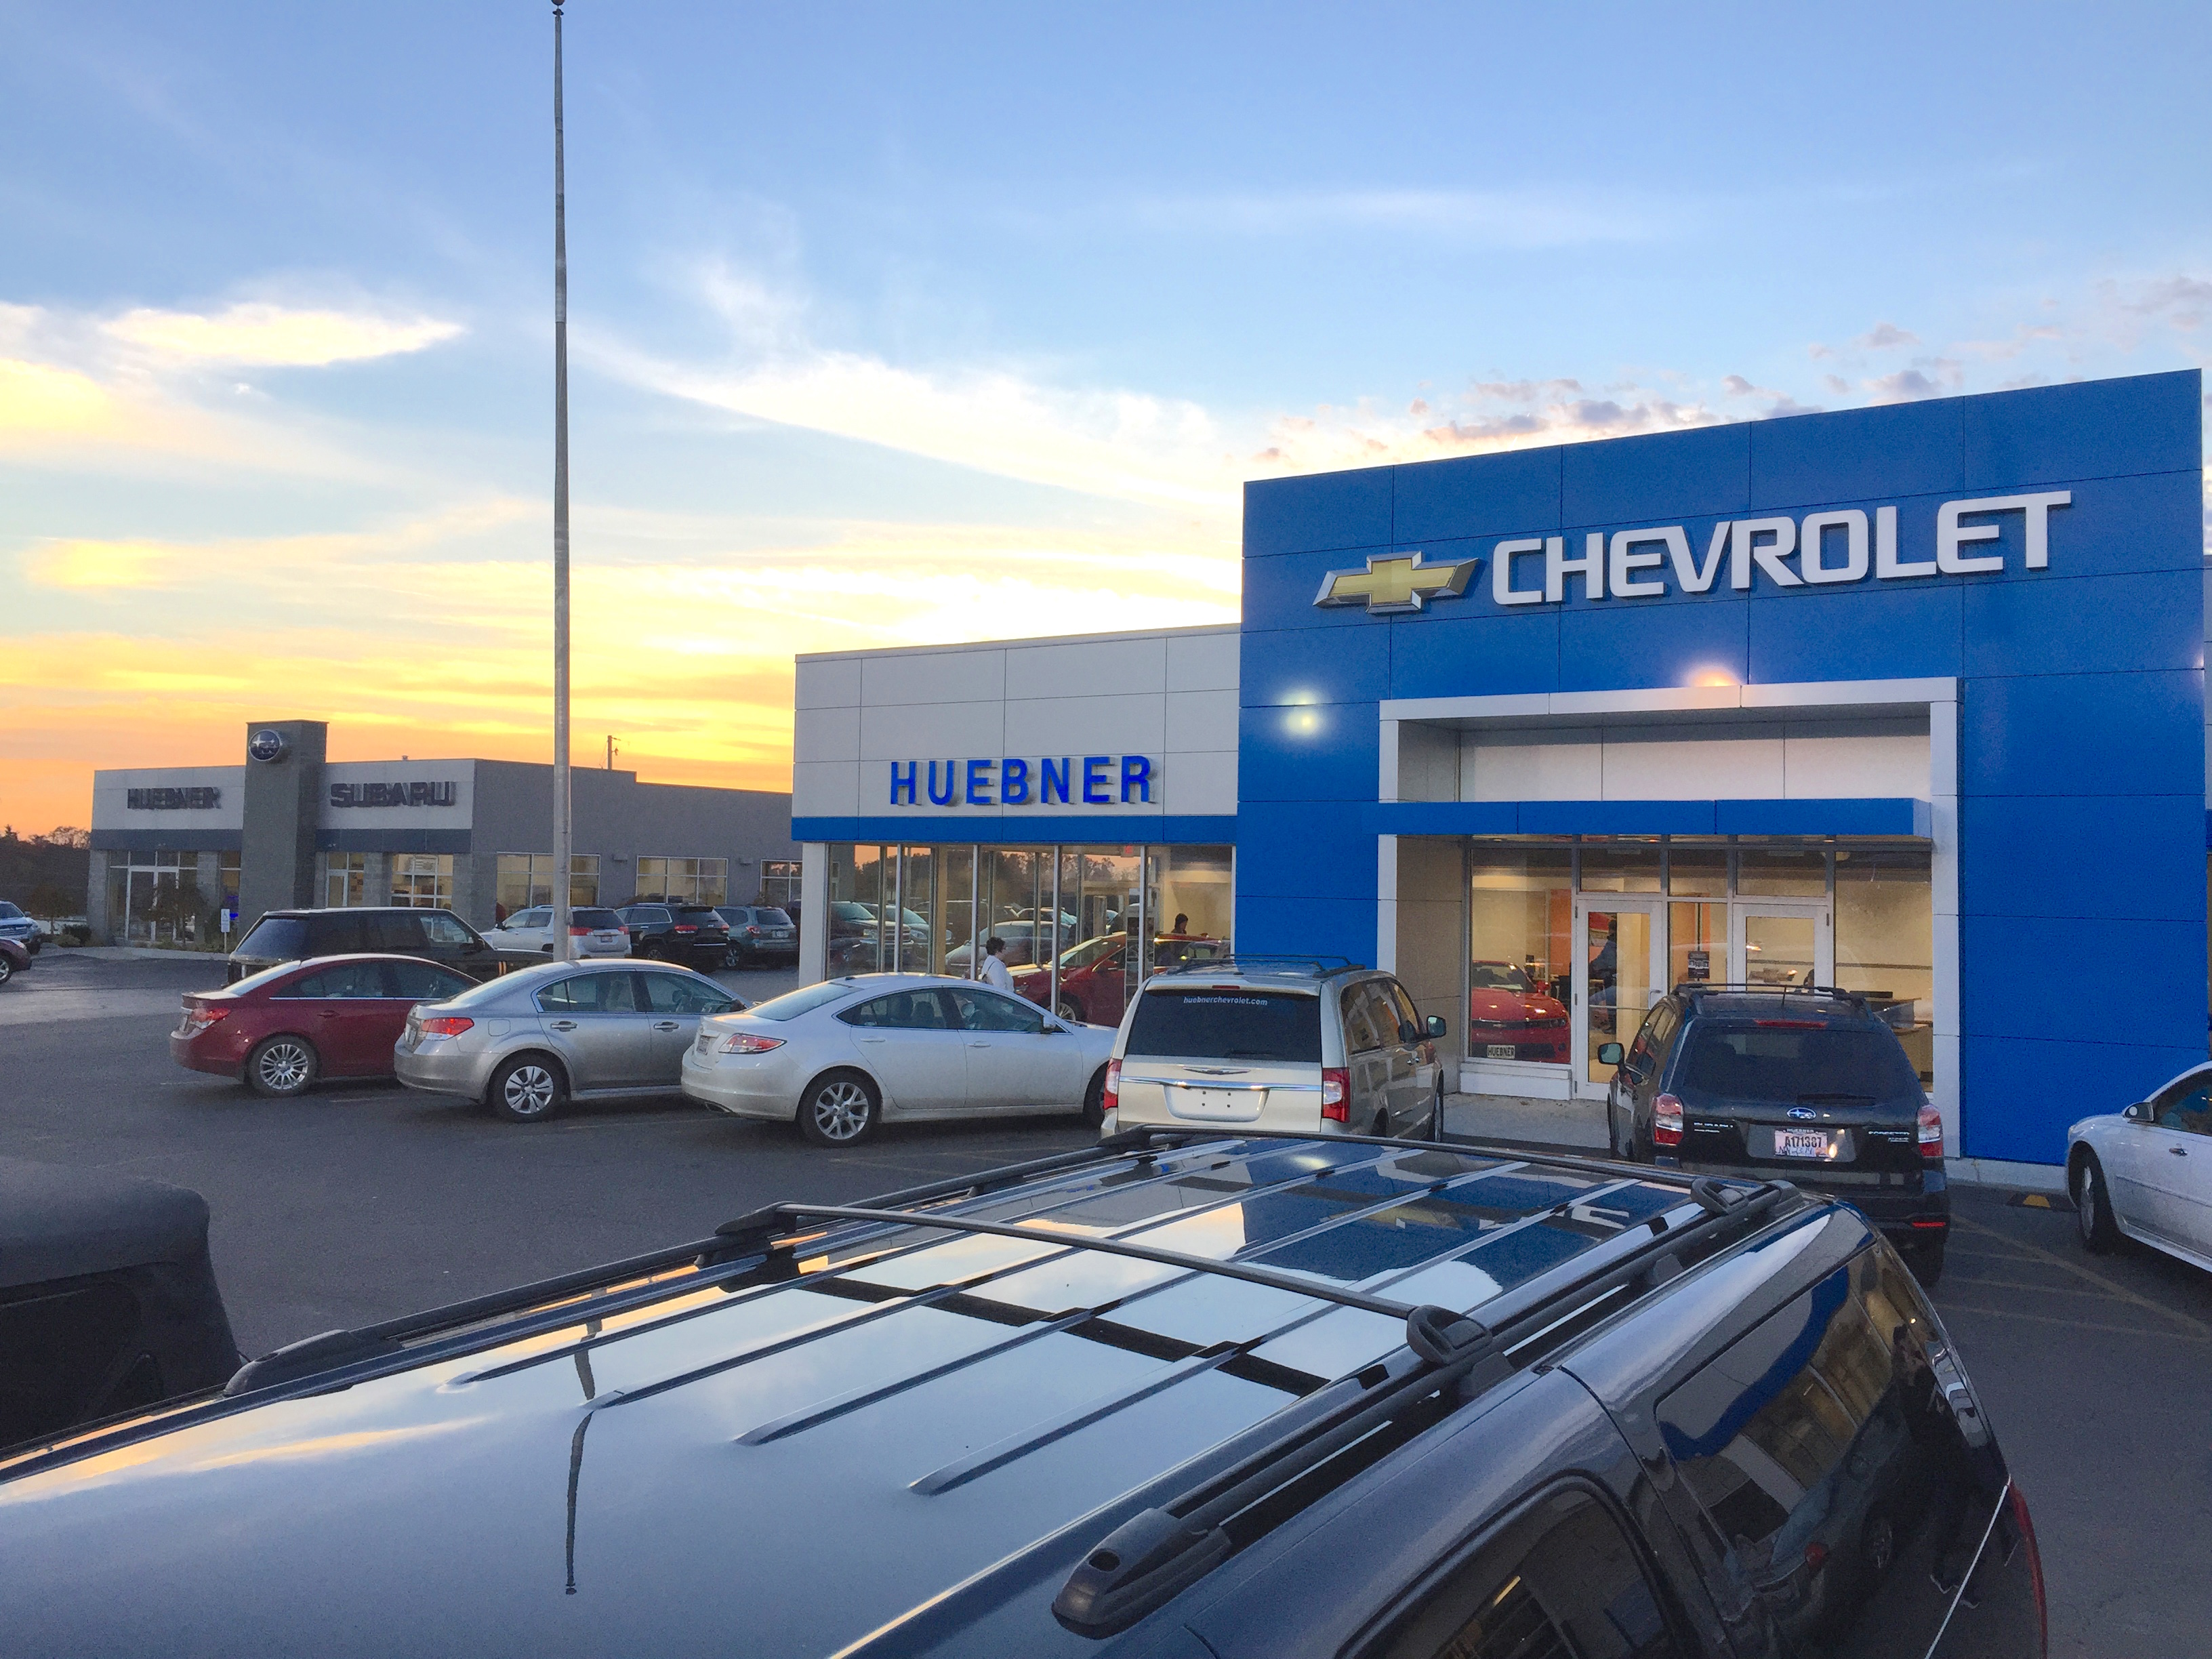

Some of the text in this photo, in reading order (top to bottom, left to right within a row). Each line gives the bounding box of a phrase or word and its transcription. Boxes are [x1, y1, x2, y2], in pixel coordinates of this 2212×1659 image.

[1492, 491, 2072, 605] CHEVROLET
[890, 755, 1153, 805] HUEBNER
[331, 781, 455, 806] SUBARU
[1183, 996, 1268, 1006] huebnerchevrolet.com
[1488, 1046, 1514, 1057] HUEBNER
[1784, 1136, 1822, 1147] A171387
